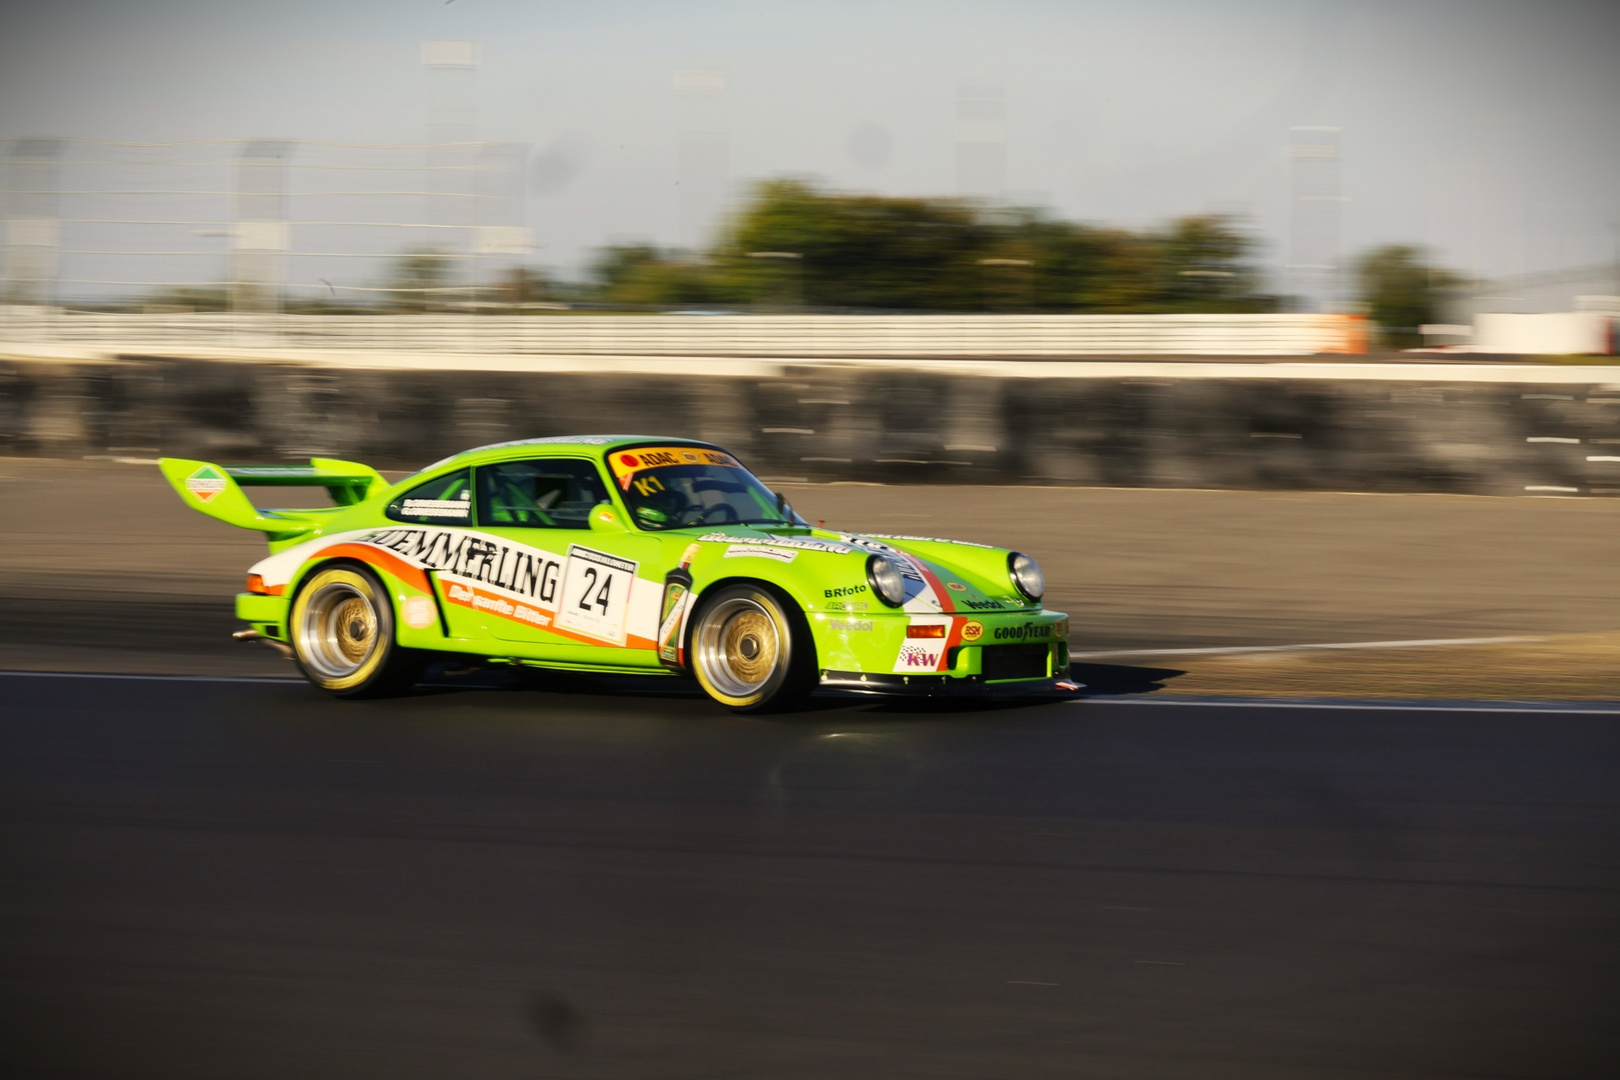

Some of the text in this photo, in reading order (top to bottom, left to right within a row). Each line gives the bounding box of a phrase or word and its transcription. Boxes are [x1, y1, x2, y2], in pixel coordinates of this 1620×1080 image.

[638, 452, 680, 466] ADAC
[633, 475, 666, 497] K1
[578, 567, 613, 616] 24
[824, 584, 867, 599] BRfoto
[961, 599, 1005, 610] Veedol
[830, 619, 874, 632] Veedol
[994, 622, 1052, 642] GOODYEAR
[906, 653, 939, 667] KW
